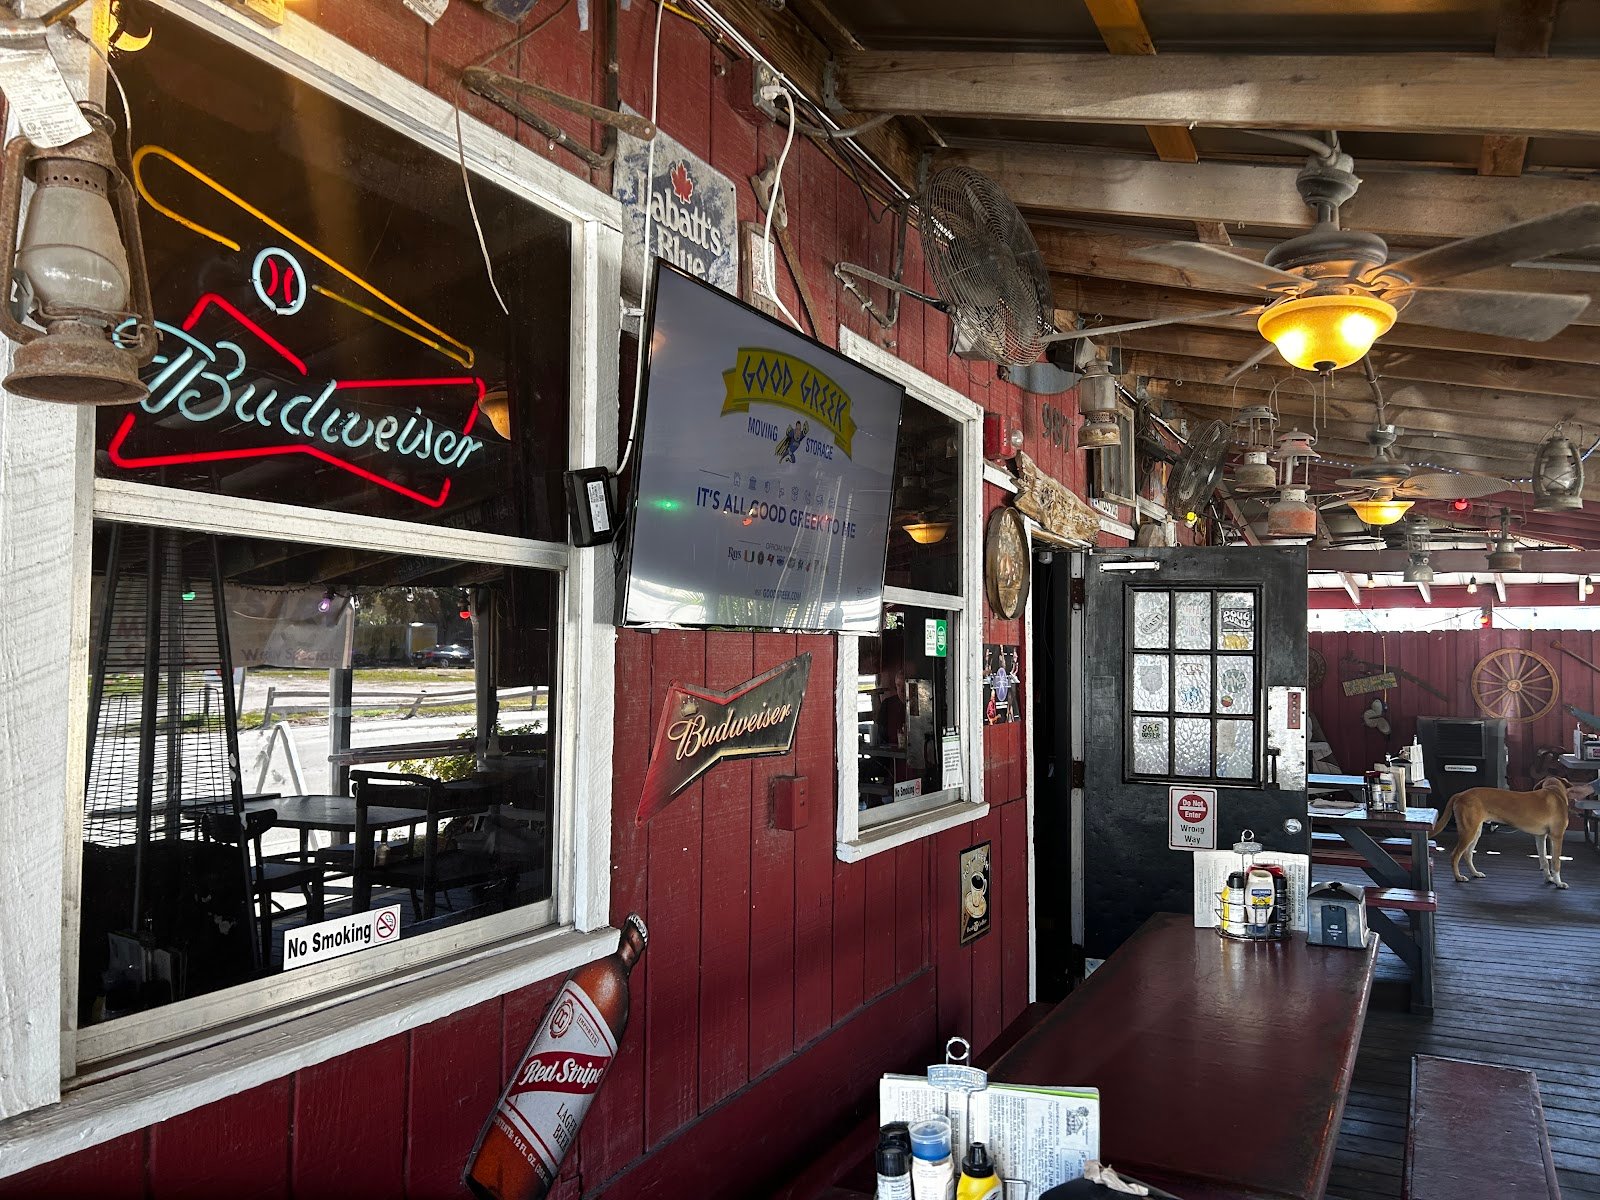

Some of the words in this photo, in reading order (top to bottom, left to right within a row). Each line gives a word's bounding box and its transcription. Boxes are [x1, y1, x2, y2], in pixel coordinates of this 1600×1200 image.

[637, 169, 724, 257] Labatt's
[656, 226, 706, 281] Blue
[112, 317, 484, 469] Budweiser
[742, 355, 794, 397] GOOD
[800, 369, 848, 433] GREEK
[748, 416, 778, 441] MOVING
[805, 438, 833, 460] STORAGE
[696, 486, 720, 510] IT'S
[723, 493, 745, 517] ALL
[750, 500, 787, 524] GOOD
[789, 509, 824, 532] GREEK
[826, 514, 840, 536] TO
[1223, 610, 1250, 621] DOUG
[667, 702, 792, 761] Budweiser
[1180, 824, 1205, 834] Wrong
[1184, 835, 1201, 844] Way
[287, 935, 308, 960] No
[312, 922, 372, 954] Smoking
[518, 1059, 560, 1086] Red
[556, 1058, 604, 1089] Stripe
[556, 1102, 578, 1137] LAGER
[512, 1136, 522, 1150] 12
